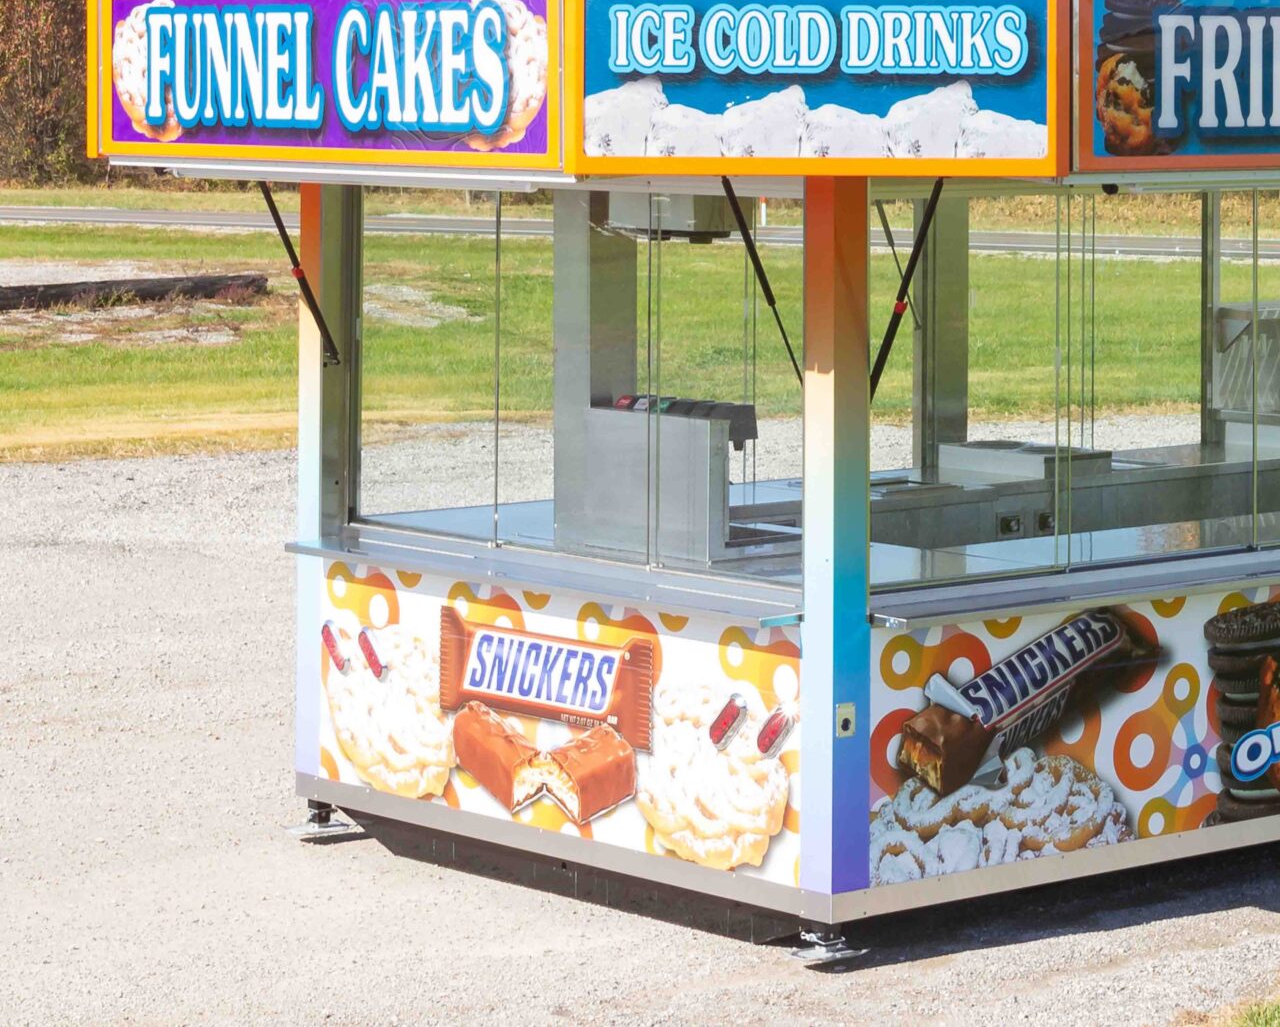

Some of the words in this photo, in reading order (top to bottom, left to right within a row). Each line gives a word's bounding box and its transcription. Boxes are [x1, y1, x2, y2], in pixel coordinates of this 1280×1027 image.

[147, 11, 322, 122] FUNNEL
[337, 8, 505, 125] CAKES
[614, 10, 688, 66] ICE
[706, 10, 832, 67] COLD
[847, 10, 1021, 69] DRINKS
[469, 634, 616, 711] SNICKERS
[960, 614, 1118, 724] SNICKERS
